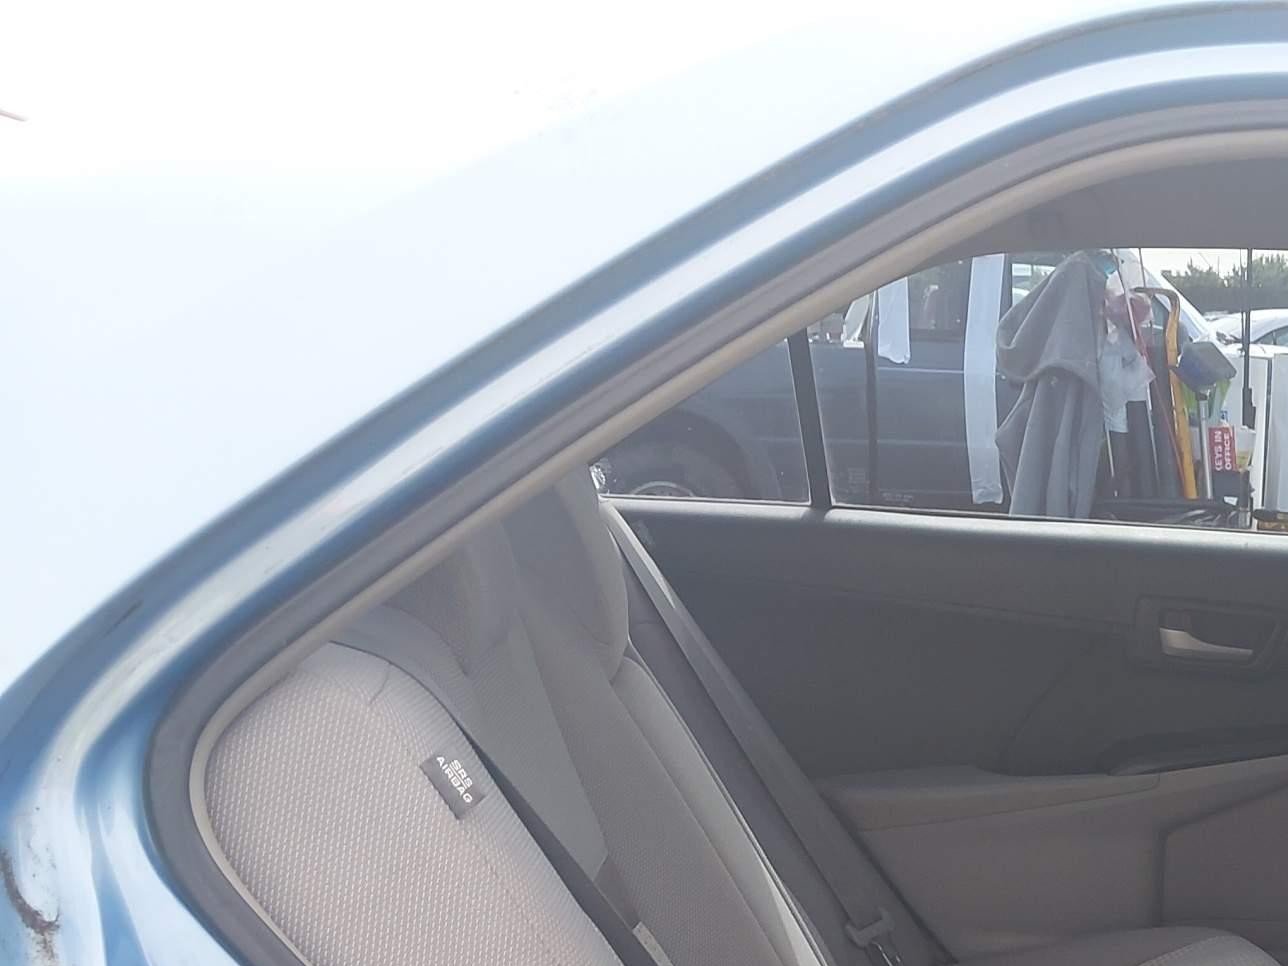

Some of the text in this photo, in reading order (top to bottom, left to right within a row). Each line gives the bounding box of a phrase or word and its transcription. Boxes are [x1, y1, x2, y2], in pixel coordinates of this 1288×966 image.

[1214, 430, 1222, 443] IN
[1223, 432, 1232, 470] OFFICE
[436, 756, 473, 803] AIRBAG
[452, 759, 473, 788] SRS
